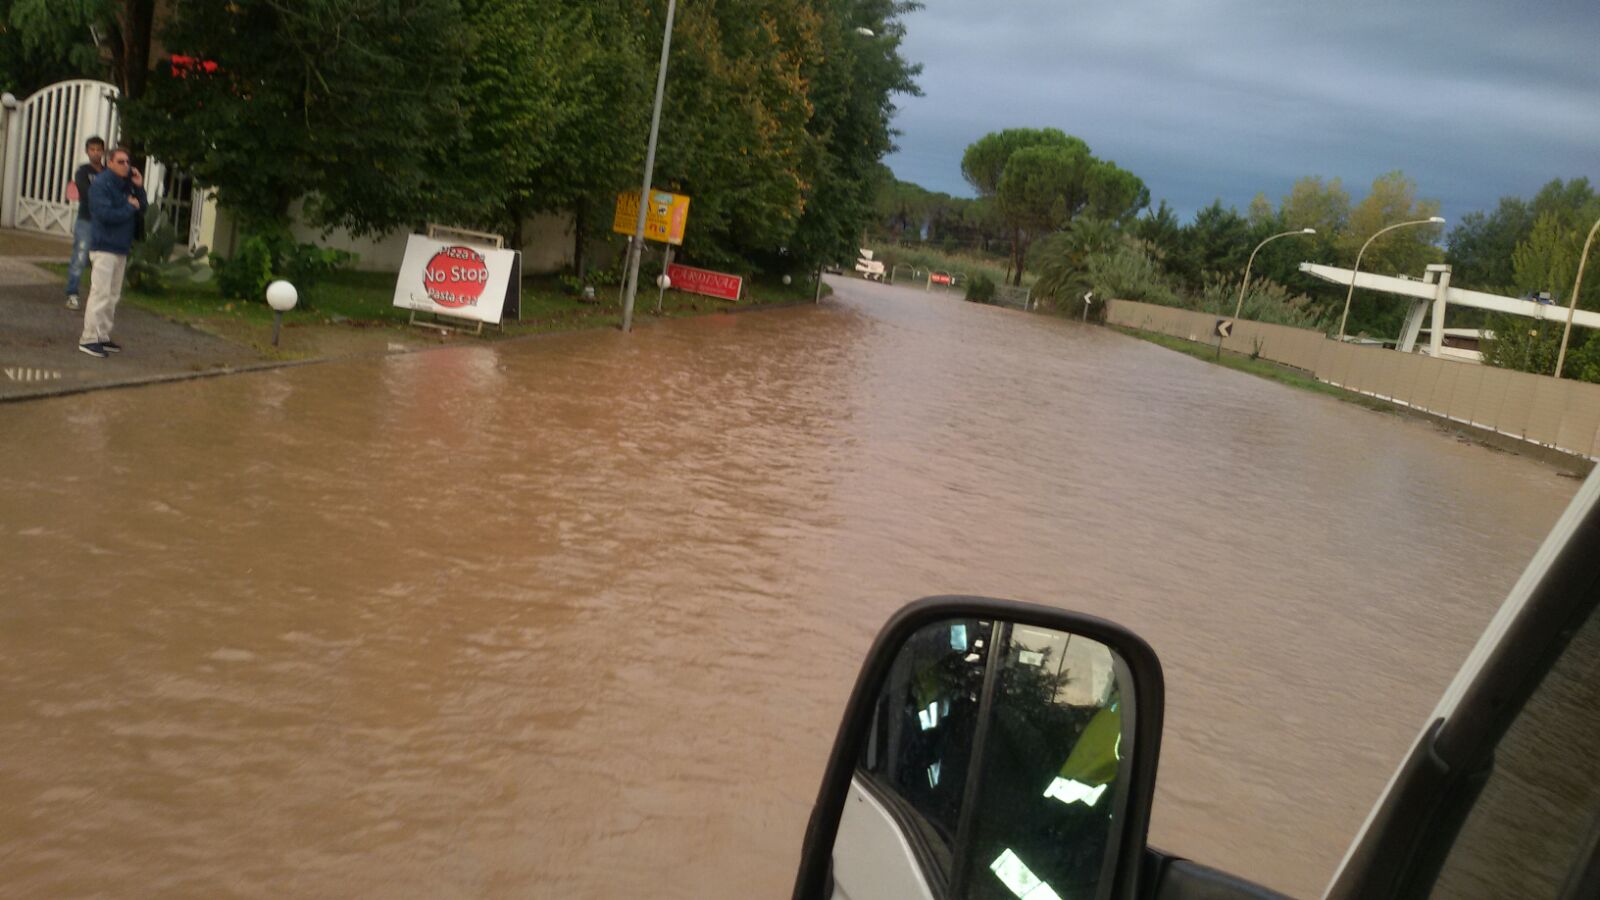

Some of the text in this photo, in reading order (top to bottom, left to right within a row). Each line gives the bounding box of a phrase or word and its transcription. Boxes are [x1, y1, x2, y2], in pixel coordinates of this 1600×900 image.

[439, 246, 469, 260] Pizza
[422, 266, 489, 285] No Stop
[671, 268, 738, 290] CARDINAL
[427, 288, 456, 303] Pasta
